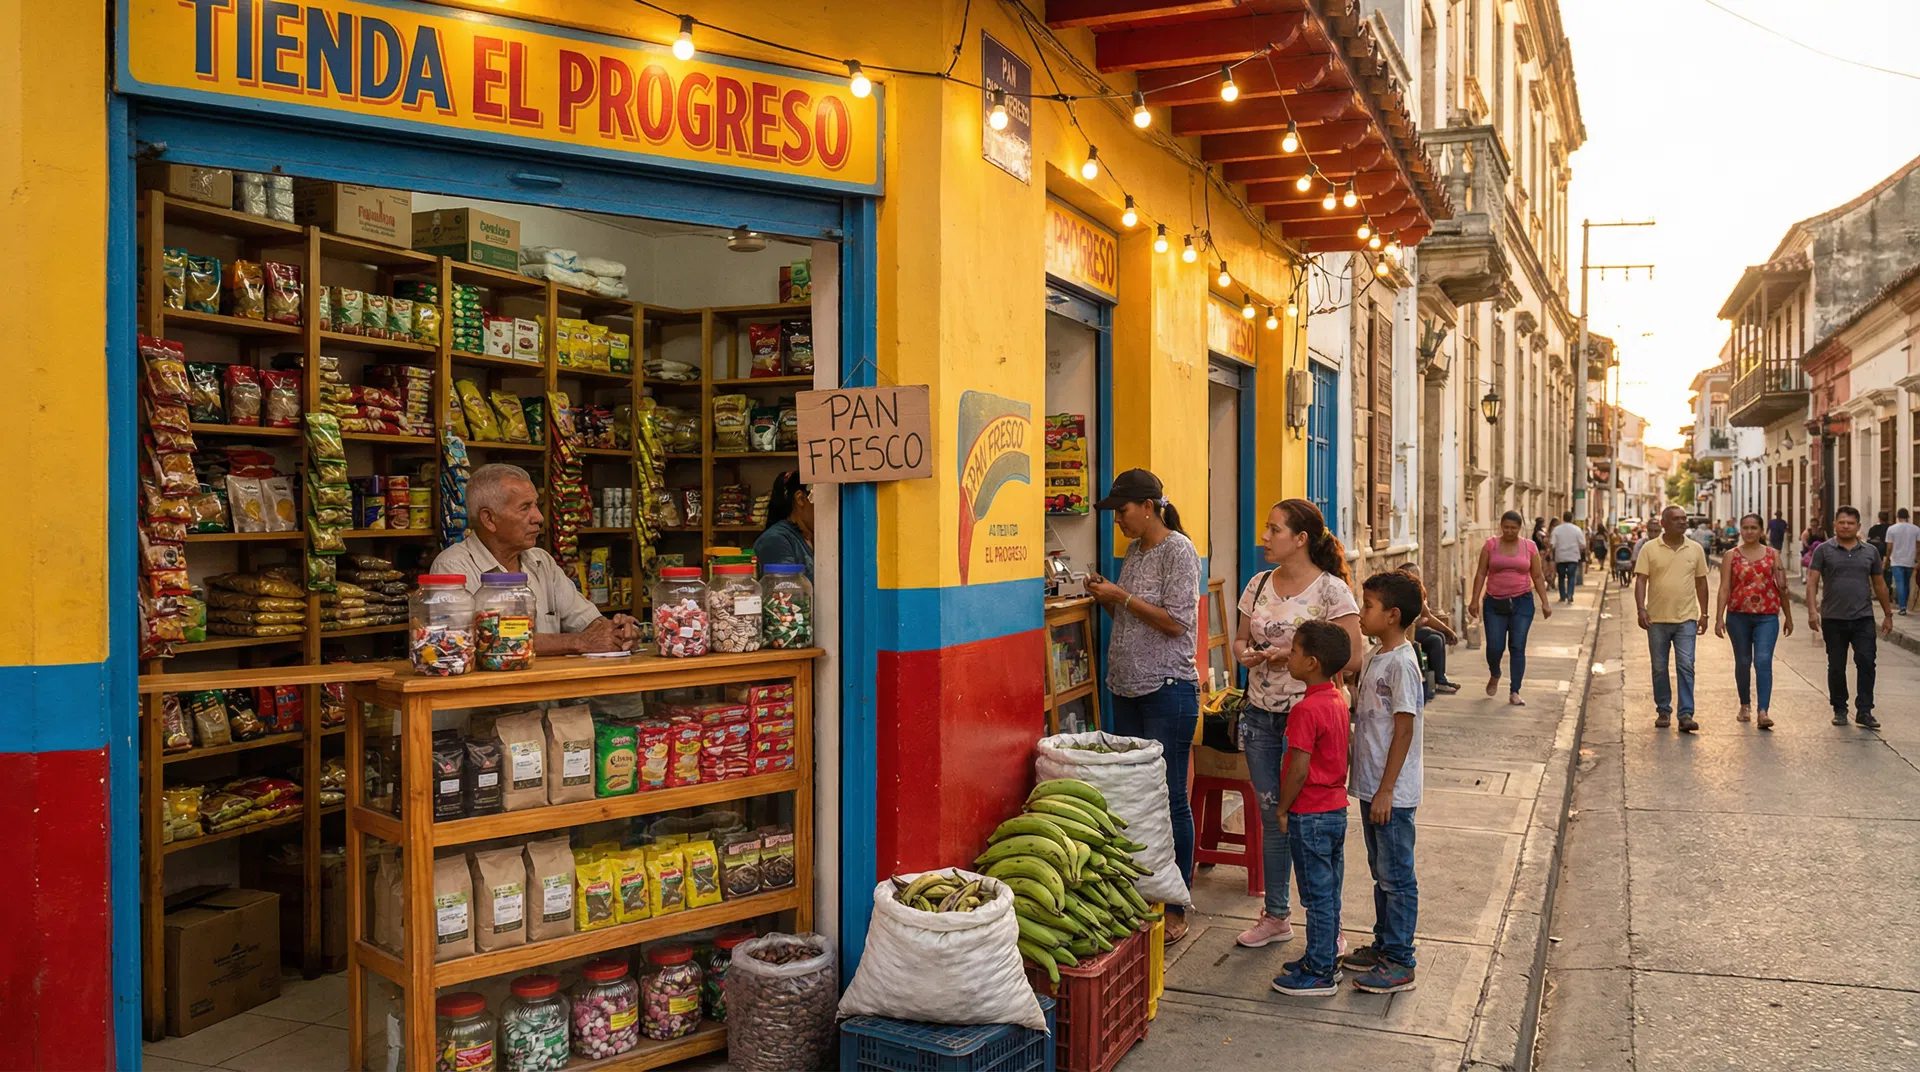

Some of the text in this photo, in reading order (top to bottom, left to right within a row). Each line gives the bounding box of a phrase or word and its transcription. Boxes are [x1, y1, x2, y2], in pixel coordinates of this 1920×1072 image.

[181, 0, 851, 170] TIENDA EL PROGRESO
[1002, 56, 1017, 88] PAN
[821, 392, 898, 431] PAN
[808, 432, 923, 475] FRESCO
[966, 419, 1024, 492] PAN FRESCO
